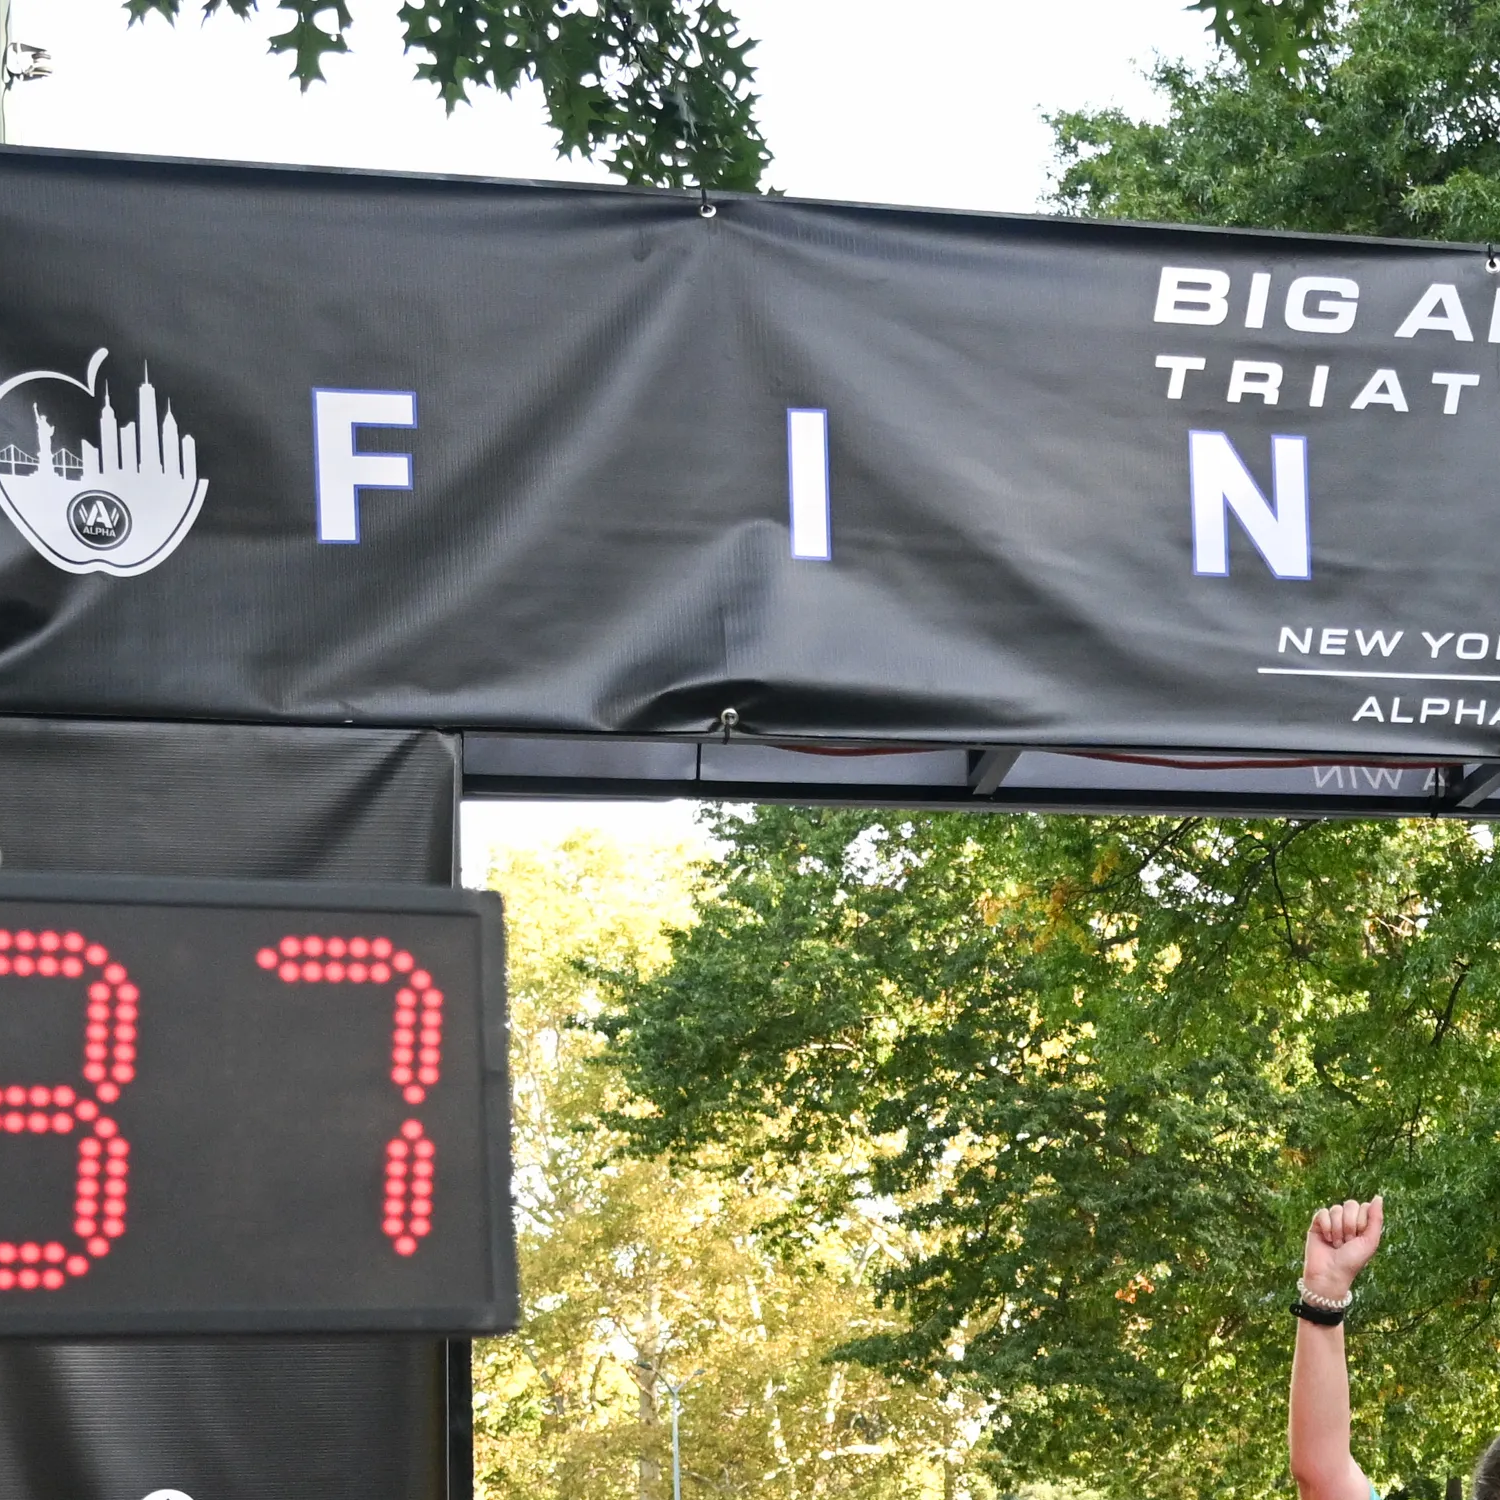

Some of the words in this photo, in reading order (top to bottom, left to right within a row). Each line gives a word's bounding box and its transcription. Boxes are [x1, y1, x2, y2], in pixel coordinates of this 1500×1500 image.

[1152, 266, 1361, 335] BIG
[82, 526, 117, 538] ALPHA
[1277, 625, 1404, 658] NEW
